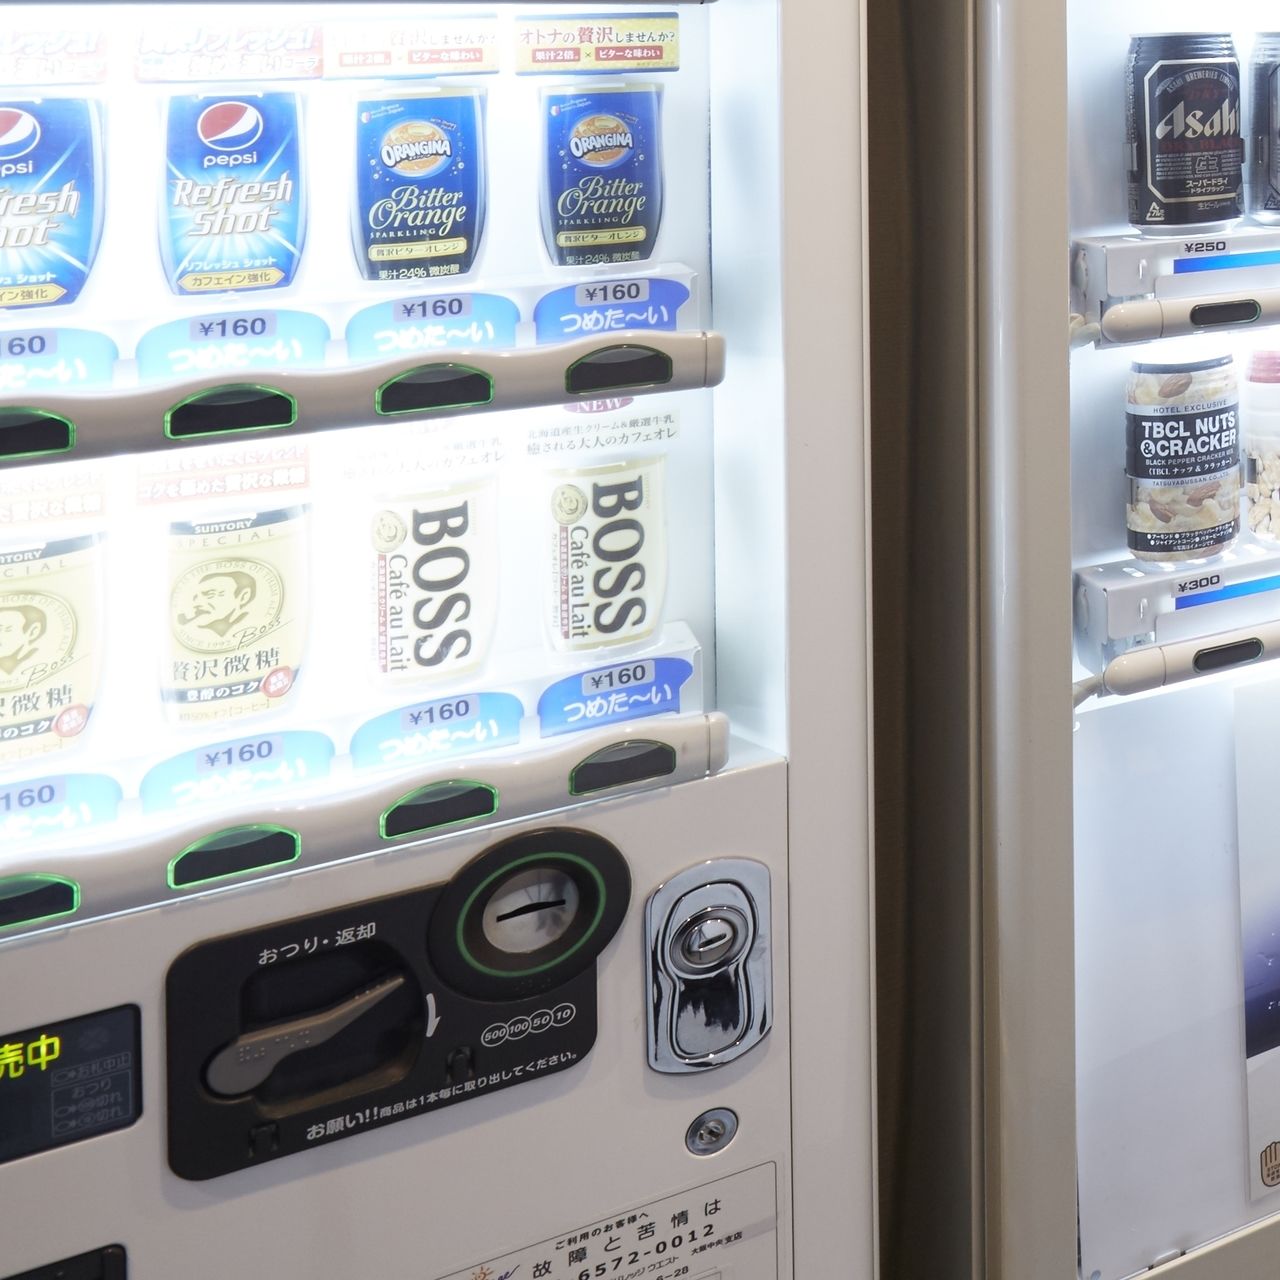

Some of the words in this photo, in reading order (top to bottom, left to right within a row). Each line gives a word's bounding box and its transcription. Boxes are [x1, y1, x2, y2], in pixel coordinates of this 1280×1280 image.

[519, 24, 677, 45] オトナの贅沢しませんか?
[598, 48, 661, 63] ビターな味わい
[380, 139, 453, 168] ORANGINA
[569, 131, 635, 160] ORANGINA
[203, 151, 258, 169] pepsi
[173, 170, 294, 208] Refresh
[578, 174, 645, 199] Bitter
[1186, 175, 1229, 189] スーパードライ
[391, 184, 464, 211] Bitter
[557, 188, 649, 225] Orange
[187, 204, 279, 237] Shot
[368, 199, 468, 237] Orange
[558, 216, 620, 227] SPARKLING
[370, 227, 437, 240] SPARKLING
[1184, 240, 1227, 252] ¥250
[191, 270, 273, 288] カフェイン強化
[585, 282, 643, 303] ¥160
[402, 297, 464, 319] ¥160
[560, 305, 670, 332] つめた〜い
[199, 317, 268, 339] ¥160
[1152, 405, 1181, 415] HOTEL
[1184, 398, 1228, 412] EXCLUSIVE
[1141, 418, 1191, 439] TBCL
[1195, 411, 1236, 435] NUTS
[1139, 429, 1237, 459] &CRACKER
[1144, 457, 1165, 466] BLACK
[1167, 455, 1195, 464] PEPPER
[1196, 451, 1223, 462] CRACKER
[569, 524, 591, 570] Café
[592, 474, 649, 636] BOSS
[388, 553, 410, 601] Café
[412, 499, 473, 669] BOSS
[570, 572, 586, 600] au
[1176, 574, 1220, 591] ¥300
[388, 605, 403, 630] au
[570, 601, 592, 640] Lait
[172, 646, 281, 683] 贅沢微糖
[388, 634, 410, 673] Lait
[591, 664, 648, 689] ¥160
[408, 699, 471, 726] ¥160
[563, 684, 674, 723] つめた〜い
[206, 739, 274, 768] ¥160
[258, 921, 378, 966] おつり・返却
[484, 1028, 509, 1043] 500
[509, 1021, 532, 1036] 100
[532, 1017, 551, 1031] 50
[555, 1009, 574, 1023] 10
[554, 1211, 651, 1252] ご利用のお客様へ
